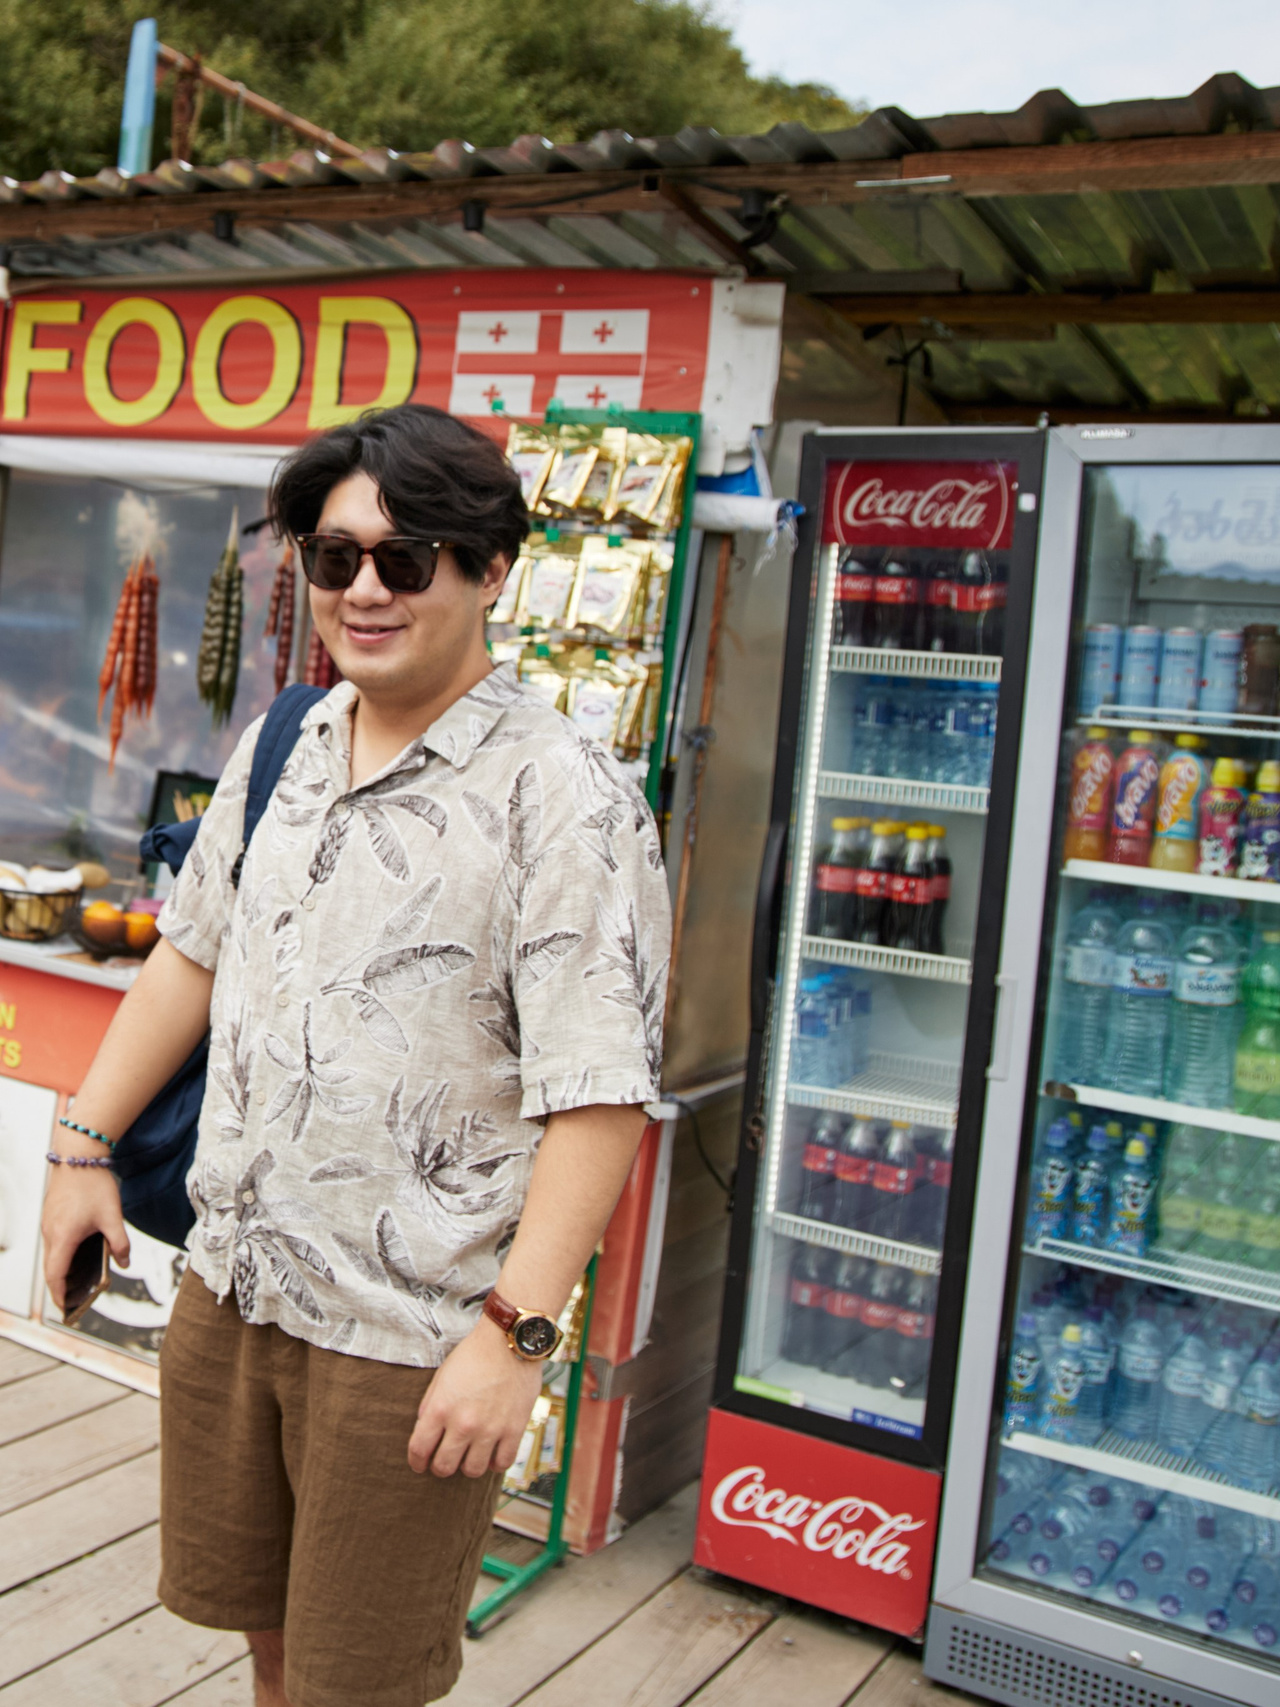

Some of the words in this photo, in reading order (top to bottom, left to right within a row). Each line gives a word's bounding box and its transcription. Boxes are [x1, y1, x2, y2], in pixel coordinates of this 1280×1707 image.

[3, 295, 419, 430] FOOD
[843, 478, 998, 529] Coca-Cola
[710, 1465, 927, 1576] Coca-Cola
